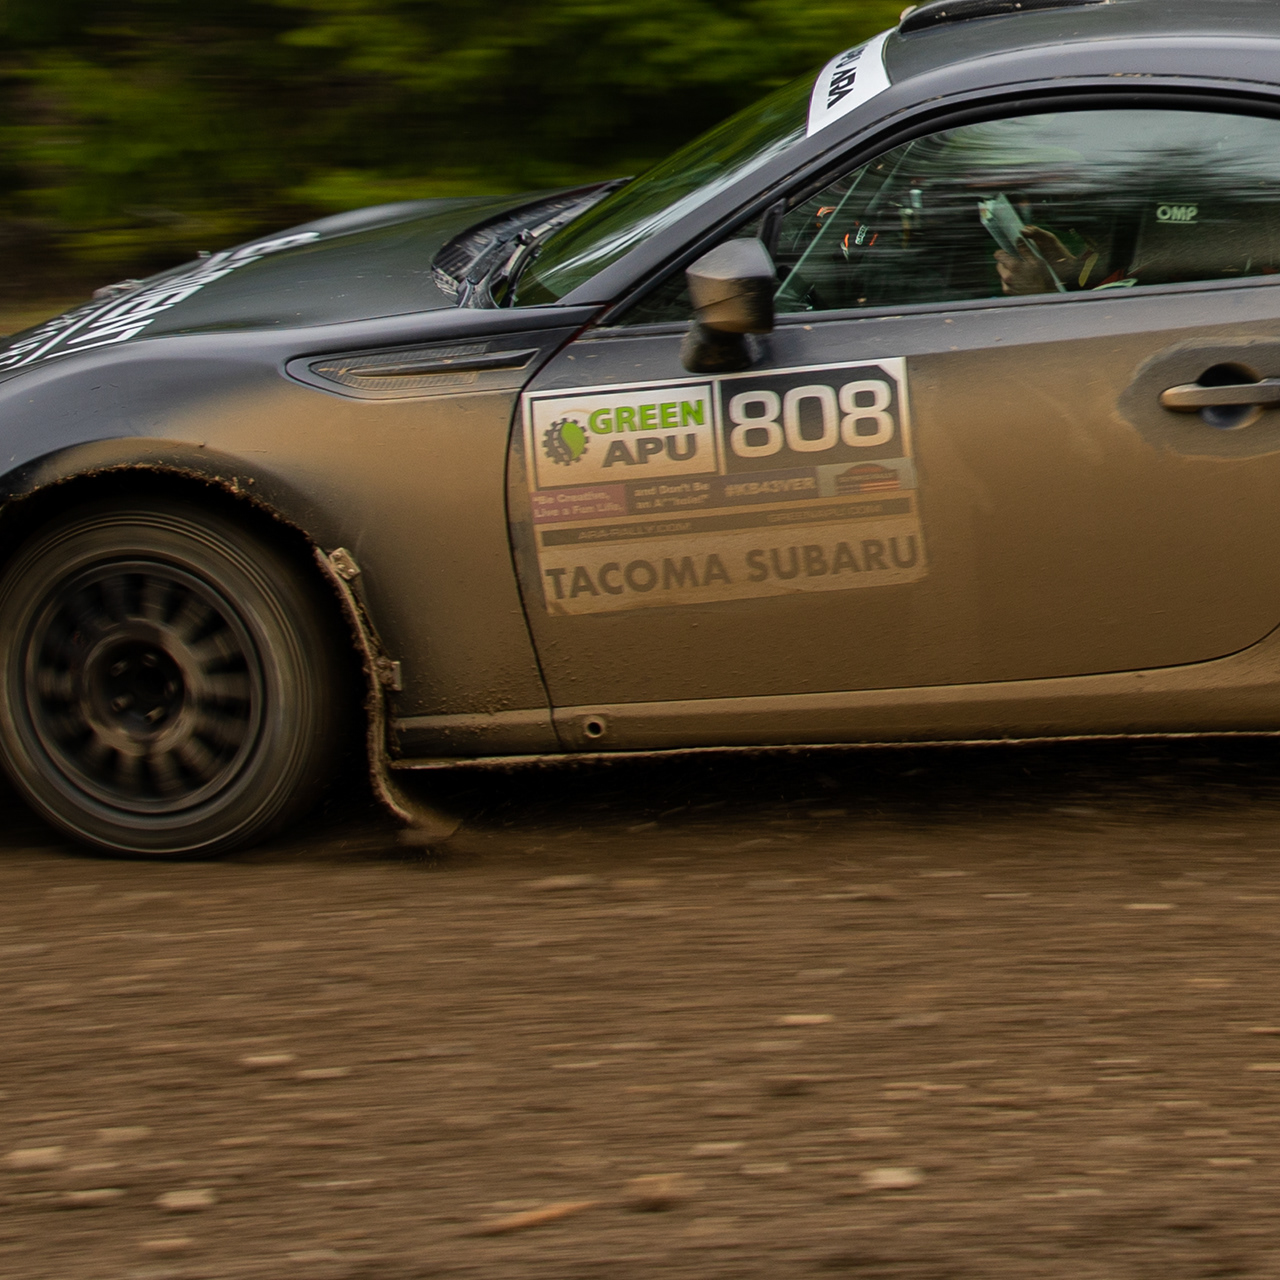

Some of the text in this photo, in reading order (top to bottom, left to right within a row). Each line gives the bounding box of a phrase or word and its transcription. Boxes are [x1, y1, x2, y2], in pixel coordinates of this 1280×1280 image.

[1156, 204, 1199, 222] OMP
[588, 399, 705, 435] GREEN
[728, 379, 895, 459] 808
[602, 433, 698, 468] APU
[634, 486, 657, 497] and
[692, 482, 711, 493] Be
[534, 507, 559, 518] Live
[572, 504, 595, 515] Fun
[635, 500, 652, 510] an
[546, 534, 919, 600] TACOMA SUBARU
